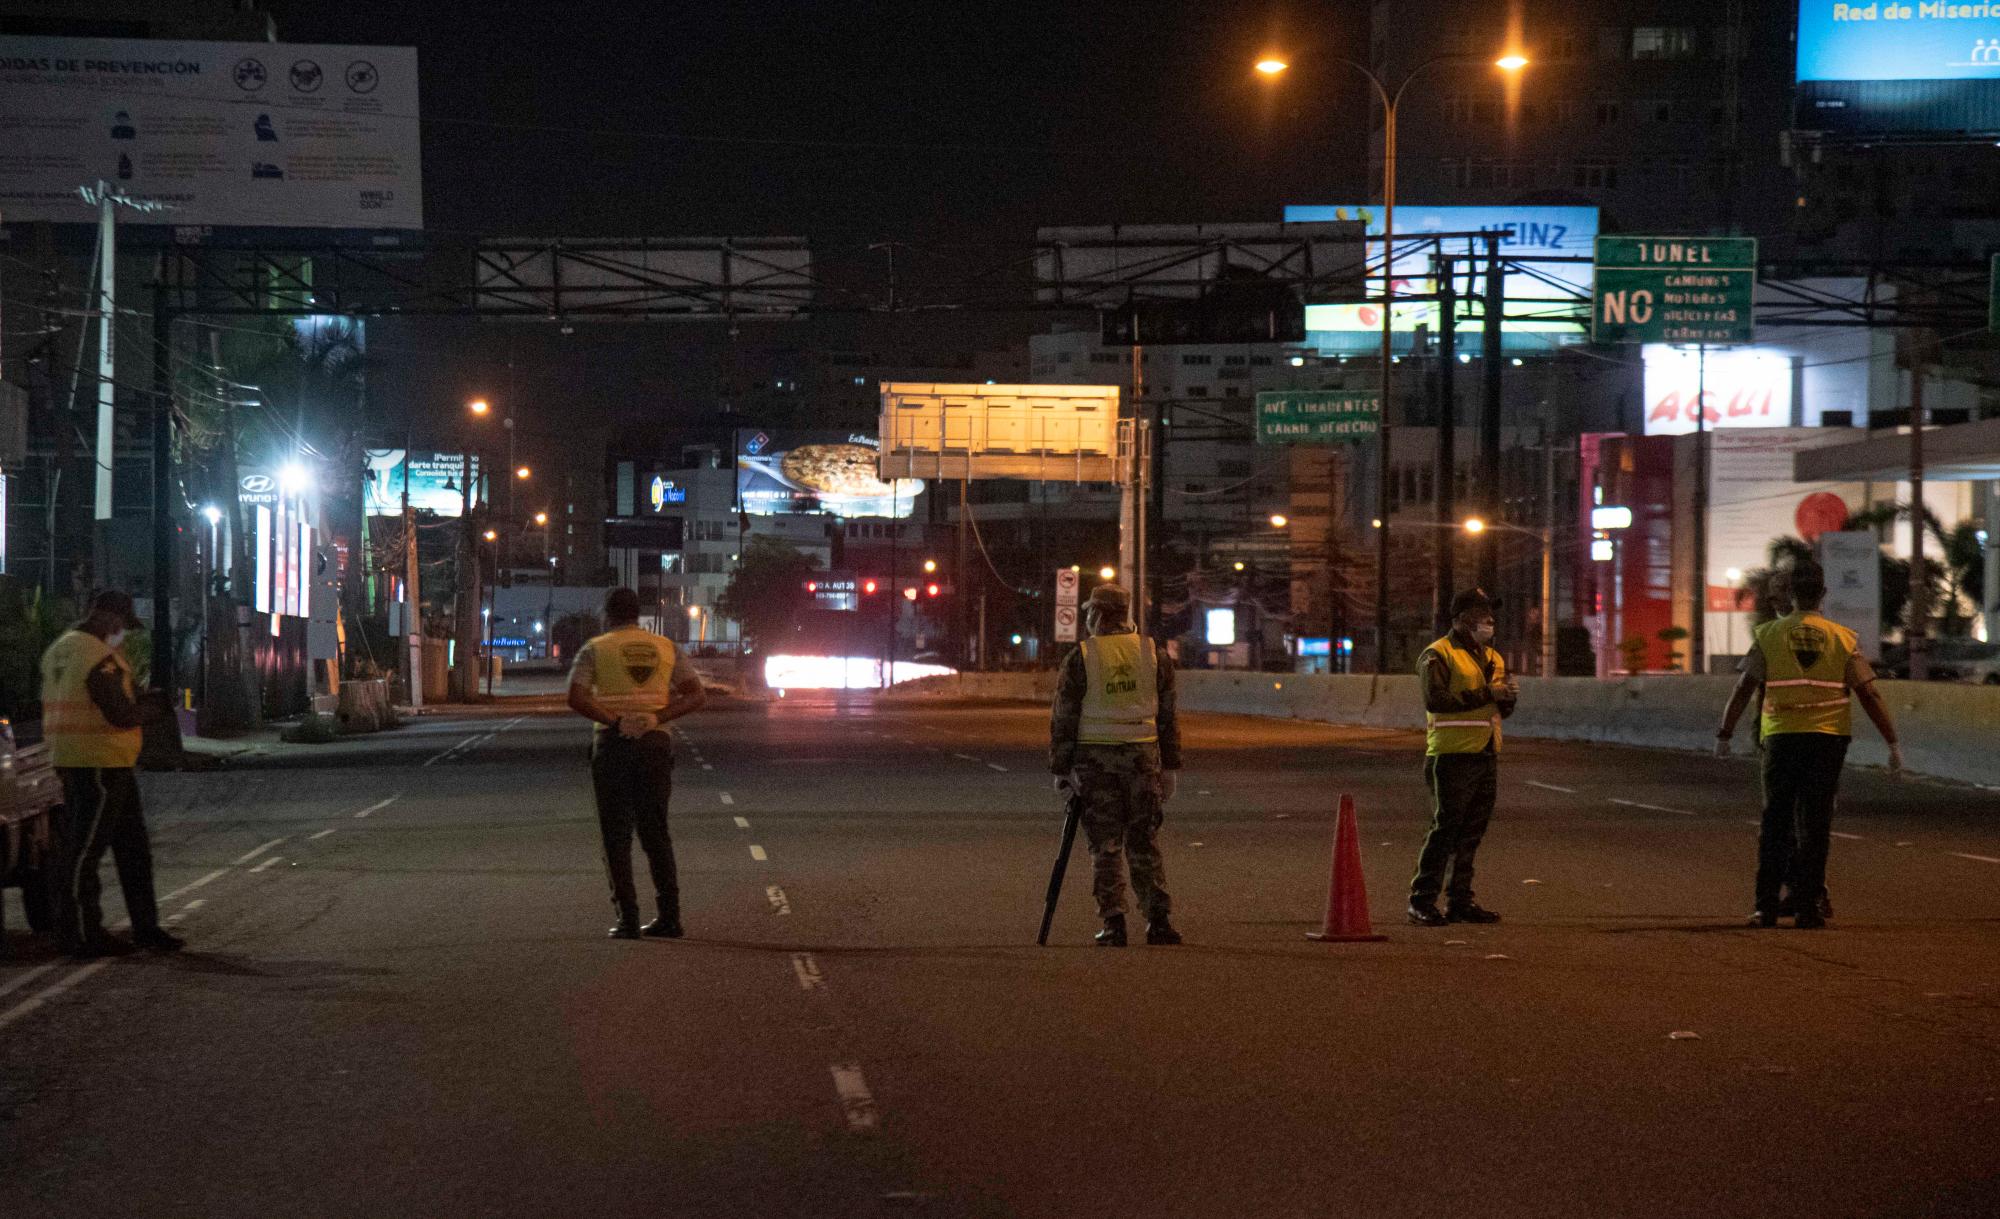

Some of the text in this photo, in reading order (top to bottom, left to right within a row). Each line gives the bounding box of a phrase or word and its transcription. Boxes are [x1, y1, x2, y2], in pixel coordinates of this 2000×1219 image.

[1833, 3, 1877, 21] Red
[1883, 3, 1912, 20] de
[56, 59, 80, 72] DE
[85, 57, 200, 75] PREVENCIÓN
[1638, 243, 1712, 262] TUNEL
[1603, 290, 1654, 324] NO
